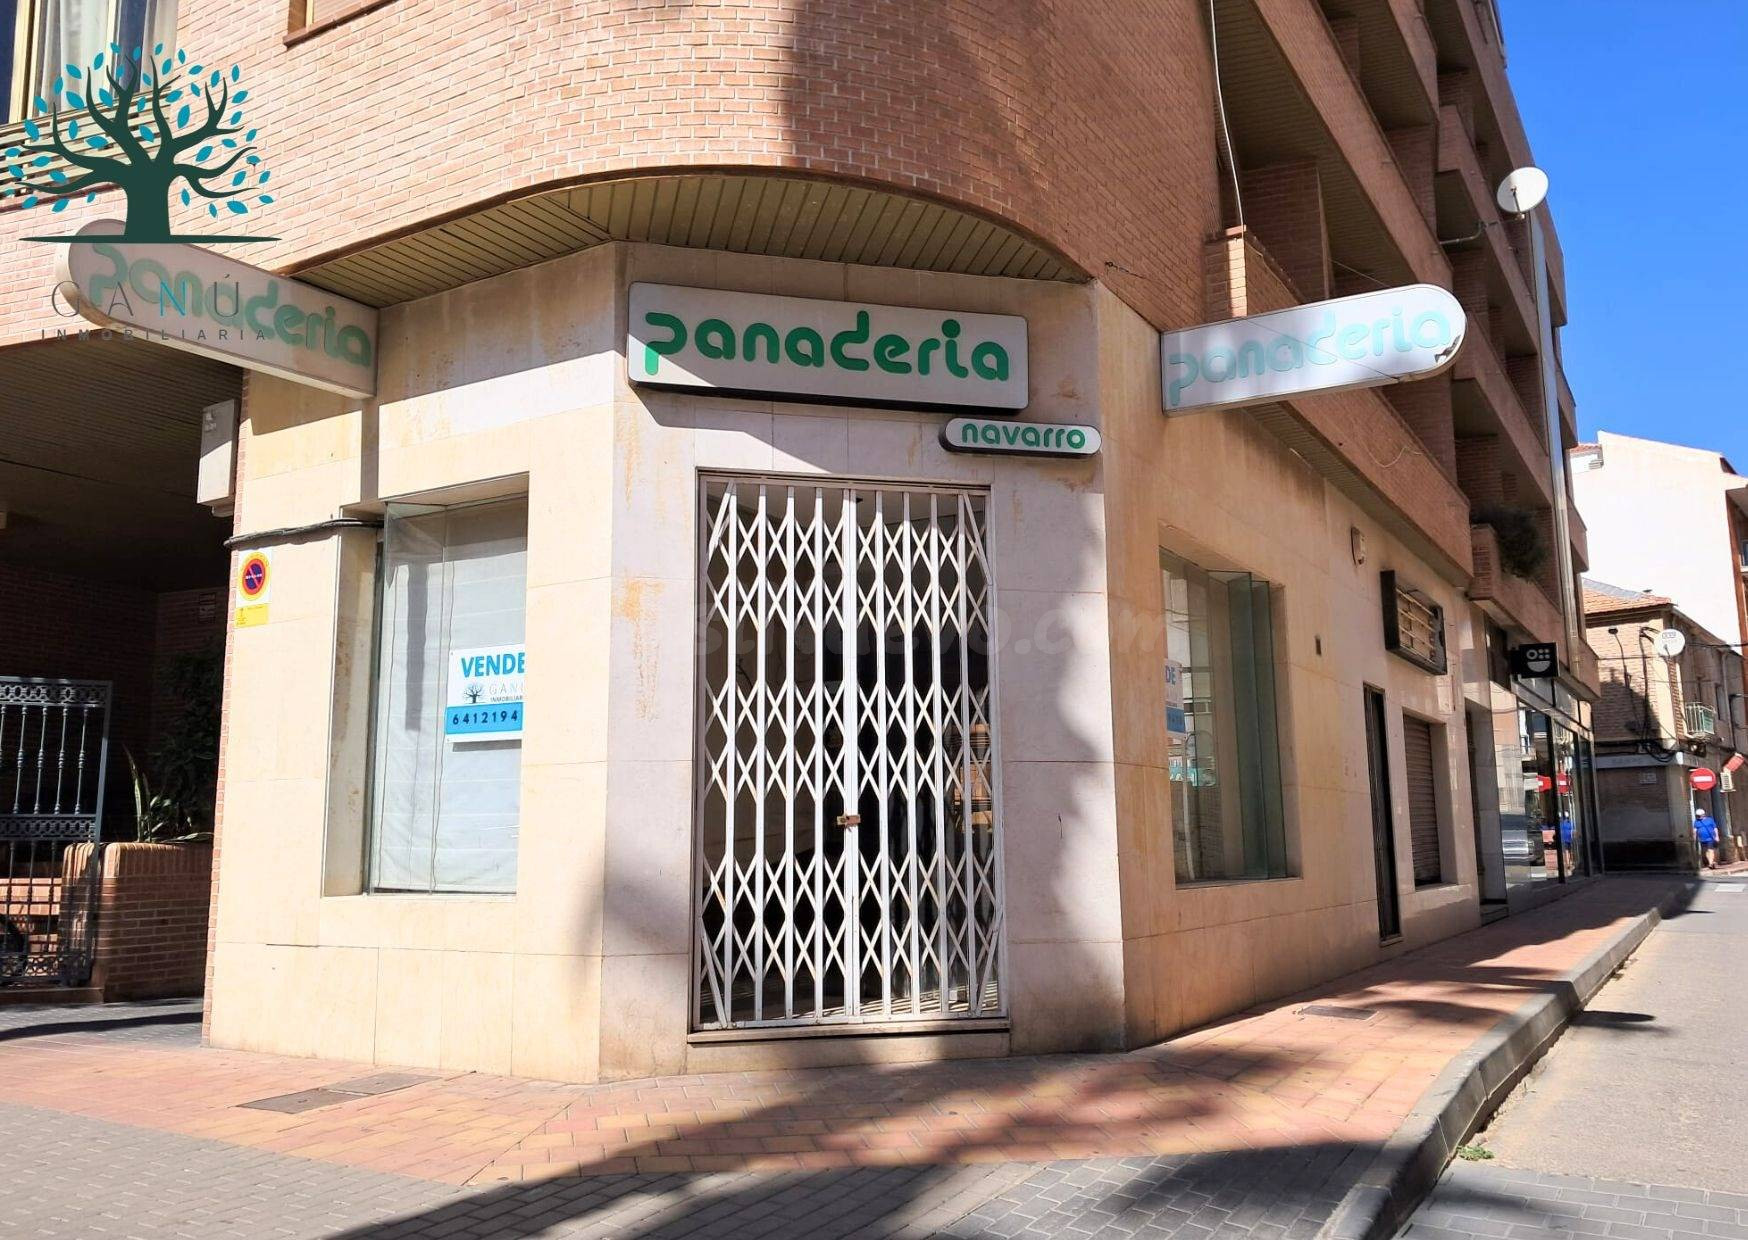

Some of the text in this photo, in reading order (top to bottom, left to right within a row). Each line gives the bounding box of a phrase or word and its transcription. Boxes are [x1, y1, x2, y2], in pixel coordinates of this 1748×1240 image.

[644, 309, 1010, 381] panaderia
[961, 421, 1087, 450] navarro
[461, 652, 526, 678] VENDE
[452, 710, 518, 725] 6412194
